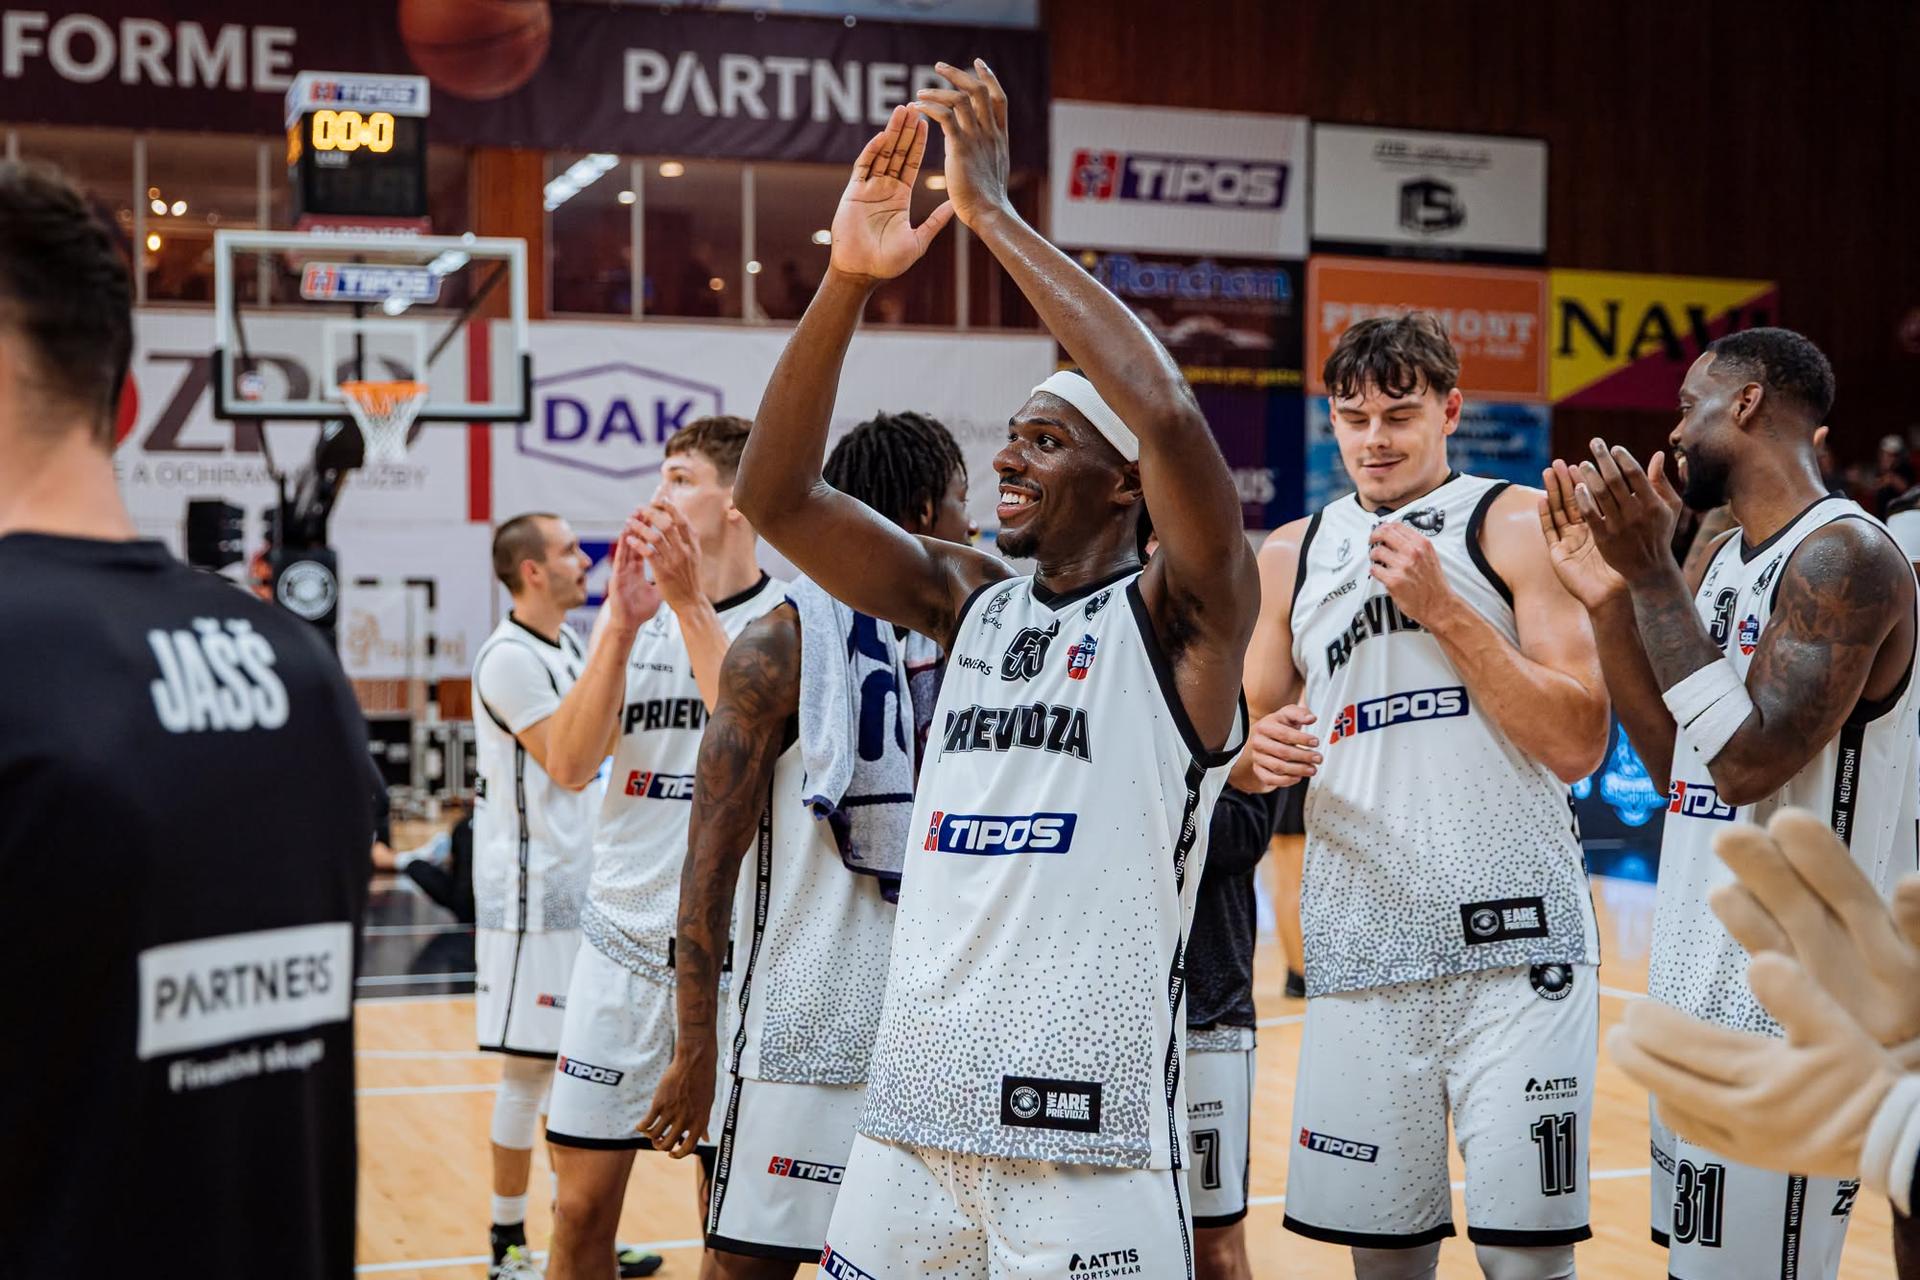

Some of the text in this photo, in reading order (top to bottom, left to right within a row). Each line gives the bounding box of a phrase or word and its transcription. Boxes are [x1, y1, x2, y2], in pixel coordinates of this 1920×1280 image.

[2, 10, 297, 93] FORME
[623, 47, 955, 125] PARTNE
[1129, 160, 1279, 204] TIPOS
[1322, 302, 1535, 343] PEONT
[545, 397, 696, 444] DAK
[148, 616, 290, 733] JAŠŠ
[624, 698, 705, 735] PRIEV
[1361, 690, 1462, 726] TIPOS
[658, 777, 694, 798] TIP
[1840, 747, 1856, 804] NEÚPROSNÍ
[949, 817, 1065, 851] TIPOS
[155, 952, 333, 1022] PARTNERS
[566, 1060, 619, 1085] TIPOS
[1544, 1076, 1578, 1092] ATTIS
[1045, 1107, 1090, 1120] PRIEVIDZA
[1057, 1092, 1090, 1111] ARE
[1312, 1134, 1374, 1160] TIPOS
[1530, 1111, 1577, 1197] 11
[796, 1162, 845, 1184] TIPO
[1673, 1158, 1726, 1248] 31
[831, 1254, 871, 1280] TIP
[1089, 1248, 1140, 1271] ATTIS
[1785, 1233, 1797, 1280] EÚPROSNÍ
